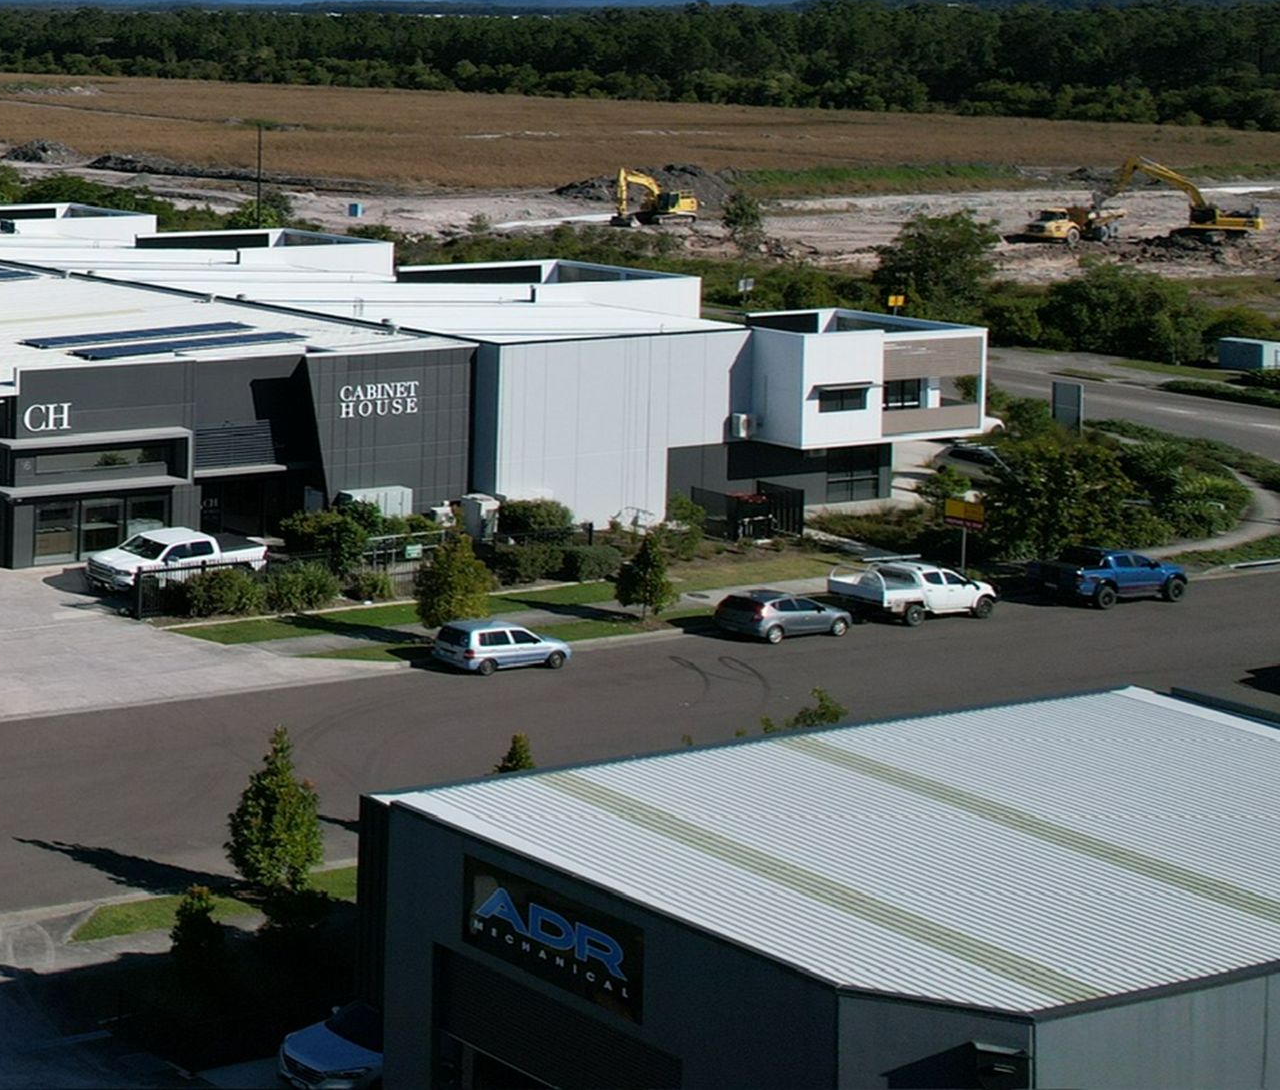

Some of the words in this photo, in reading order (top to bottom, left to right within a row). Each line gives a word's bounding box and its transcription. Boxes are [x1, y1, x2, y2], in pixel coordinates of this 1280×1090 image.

[340, 381, 419, 402] CABINET
[23, 402, 73, 432] CH
[340, 397, 418, 418] HOUSE
[475, 886, 629, 982] ADR
[472, 918, 630, 999] MECHANICAL
